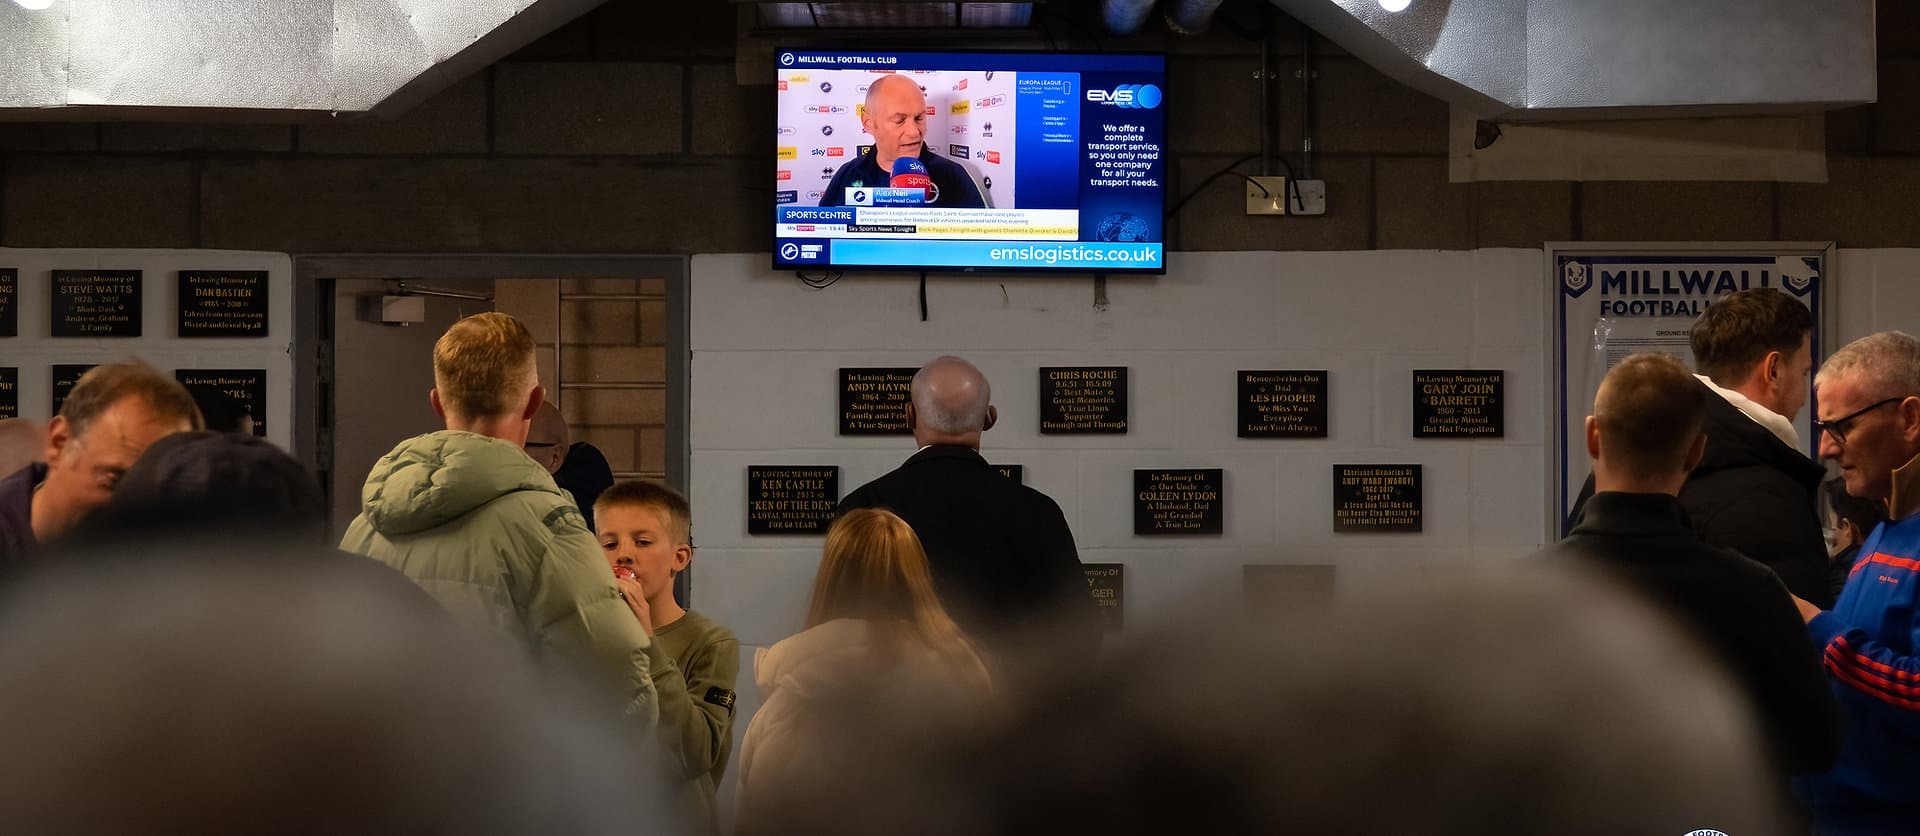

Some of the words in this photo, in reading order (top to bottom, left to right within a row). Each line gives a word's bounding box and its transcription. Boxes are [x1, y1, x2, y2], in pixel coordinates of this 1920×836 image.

[837, 56, 876, 64] FOOTBALL
[1087, 89, 1133, 101] EMS
[1103, 124, 1117, 132] We
[1118, 124, 1139, 132] offer
[1104, 133, 1144, 142] complete
[1088, 143, 1128, 151] transport
[1129, 143, 1160, 151] service,
[811, 148, 826, 157] sky
[1117, 152, 1136, 160] only
[1113, 162, 1152, 170] company
[1115, 169, 1125, 177] all
[1126, 171, 1145, 179] your
[1091, 179, 1130, 187] transport
[786, 211, 818, 219] SPORTS
[819, 211, 852, 220] CENTRE
[990, 245, 1156, 263] emslogistics.co.uk
[1601, 270, 1778, 294] MILLWALL
[60, 285, 94, 294] STEVE
[96, 285, 134, 294] WATTS
[196, 288, 215, 297] DAN
[216, 288, 252, 297] BASTIEN
[858, 374, 885, 382] Loving
[1050, 371, 1081, 380] CHRIS
[1083, 371, 1117, 380] ROCHE
[1426, 376, 1454, 384] Loving
[1455, 376, 1488, 384] Memory
[847, 383, 875, 391] ANDY
[1423, 384, 1457, 394] GARY
[1459, 384, 1495, 394] JOHN
[1250, 394, 1270, 403] LES
[1272, 394, 1317, 403] HOOPER
[1431, 395, 1488, 405] BARRETT
[852, 403, 874, 411] Sadly
[846, 412, 873, 421] Family
[1064, 413, 1103, 422] Supporter
[1430, 416, 1459, 424] Greatly
[1461, 416, 1488, 424] Missed
[1043, 421, 1076, 430] Through
[1077, 421, 1092, 429] and
[1093, 421, 1127, 430] Through
[1287, 424, 1319, 432] Always
[1423, 425, 1437, 433] But
[1439, 425, 1454, 433] Not
[1455, 425, 1496, 435] Forgotten
[1151, 473, 1160, 481] In
[1161, 473, 1193, 482] Memory
[1342, 477, 1361, 486] ANDY
[1362, 477, 1382, 486] WARD
[762, 479, 783, 490] KEN
[785, 479, 825, 490] CASTLE
[1158, 482, 1174, 490] Our
[1175, 482, 1198, 490] Uncle
[1139, 491, 1180, 501] COLEEN
[1183, 491, 1217, 501] LYDON
[776, 500, 789, 510] OF
[790, 500, 810, 510] THE
[1147, 502, 1154, 510] A
[1155, 502, 1192, 511] Husband,
[1193, 502, 1209, 510] Dad
[758, 511, 781, 519] LOYAL
[782, 511, 819, 519] MILLWALL
[821, 511, 836, 519] FAN
[1153, 511, 1168, 519] and
[1169, 511, 1203, 519] Grandad
[768, 521, 783, 529] FOR
[794, 521, 817, 529] YEARS
[1155, 520, 1162, 528] A
[1164, 520, 1183, 528] True
[1184, 520, 1201, 528] Lion
